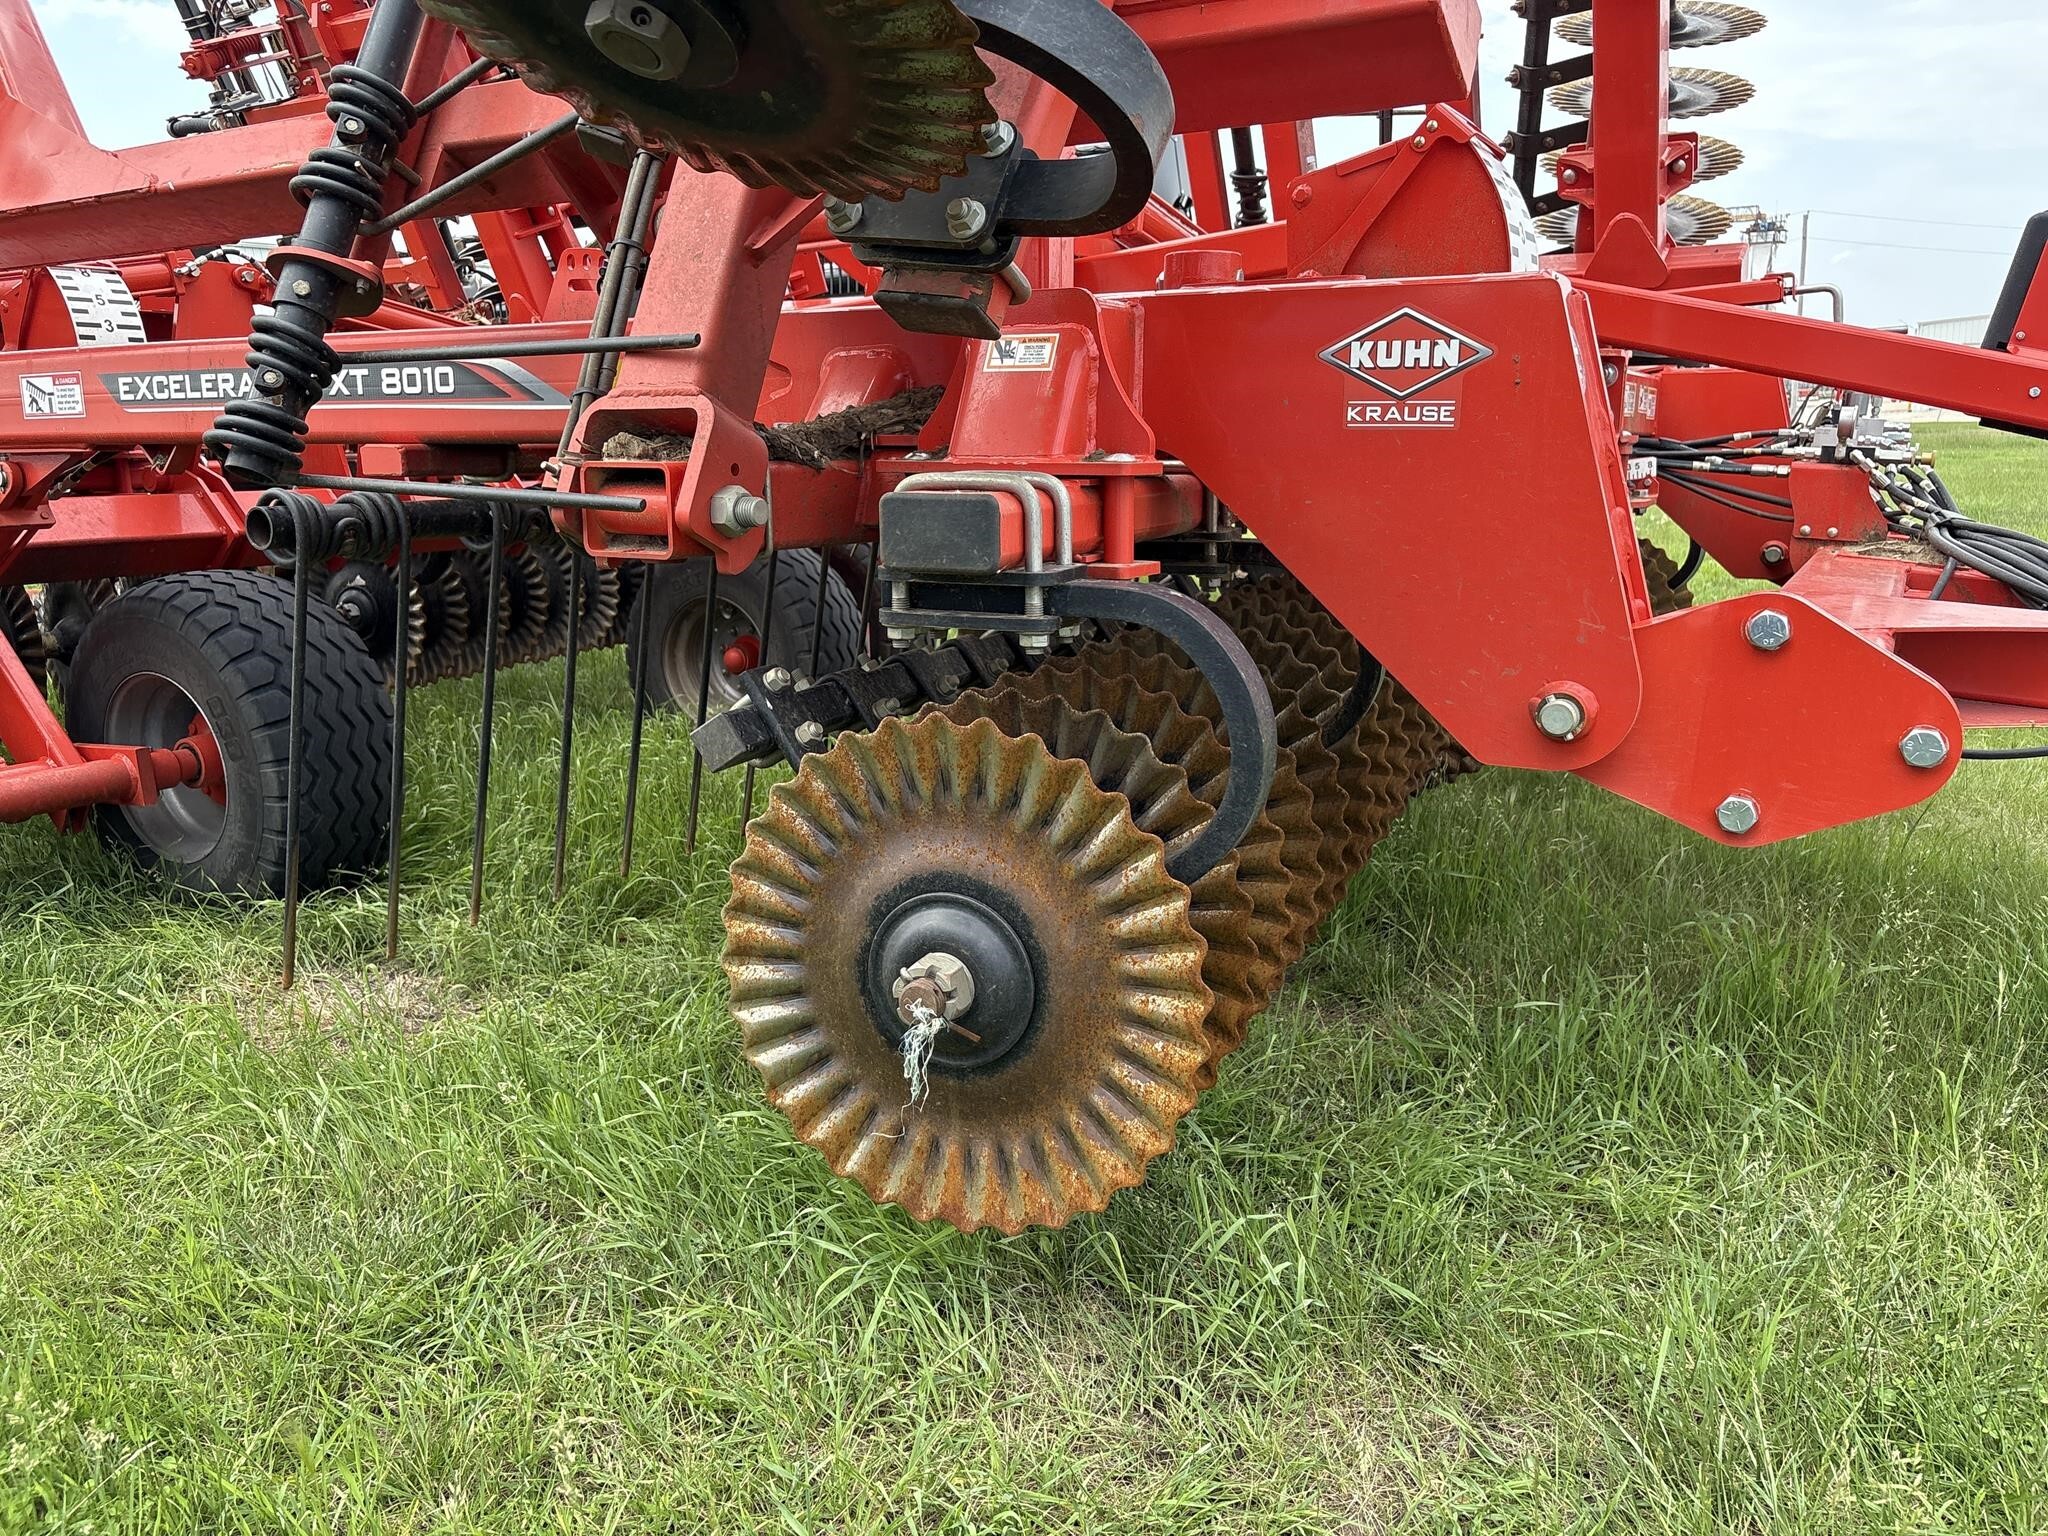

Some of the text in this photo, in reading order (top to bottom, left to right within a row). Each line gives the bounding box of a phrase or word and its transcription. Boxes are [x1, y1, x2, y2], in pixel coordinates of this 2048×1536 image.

[95, 294, 106, 306] 5
[104, 319, 115, 333] 3
[1350, 339, 1460, 369] KUHN
[117, 366, 455, 401] EXCELERA XT 8010
[1347, 406, 1456, 422] KRAUSE
